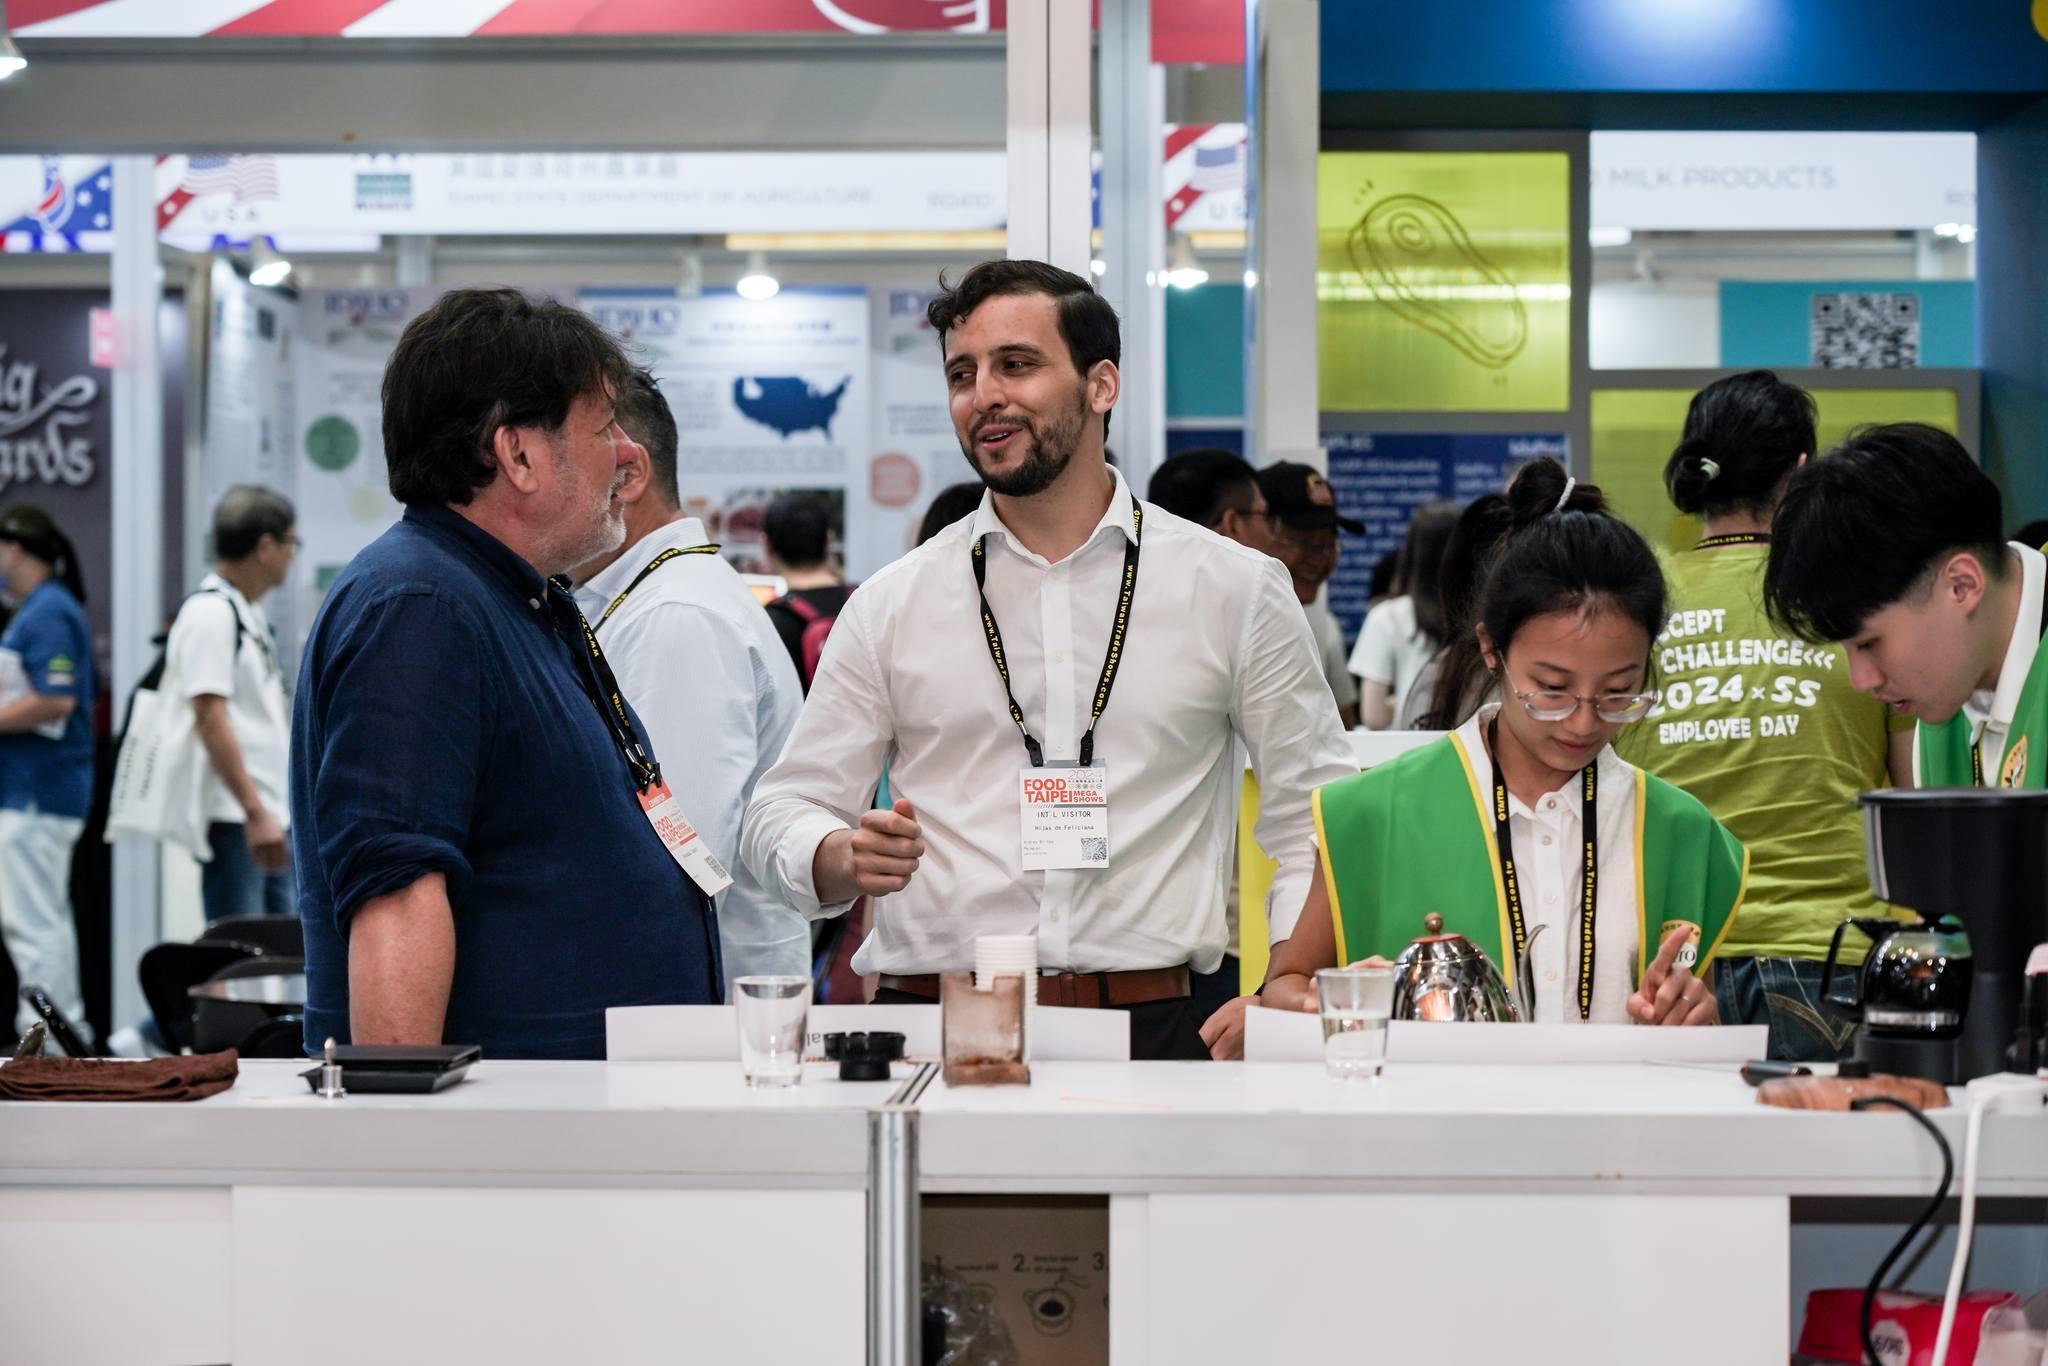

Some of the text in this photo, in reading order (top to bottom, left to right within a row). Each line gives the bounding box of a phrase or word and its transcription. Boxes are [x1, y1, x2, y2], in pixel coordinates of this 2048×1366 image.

[1610, 167, 1673, 189] MILK
[1684, 166, 1836, 190] PRODUCTS
[1771, 675, 1822, 708] SS
[1760, 714, 1800, 738] DAY
[1023, 778, 1067, 791] FOOD
[1024, 790, 1073, 803] TAIPEI
[1497, 785, 1509, 814] TAITRA
[1580, 842, 1594, 1016] www.TaiwanTradeShows.com.t
